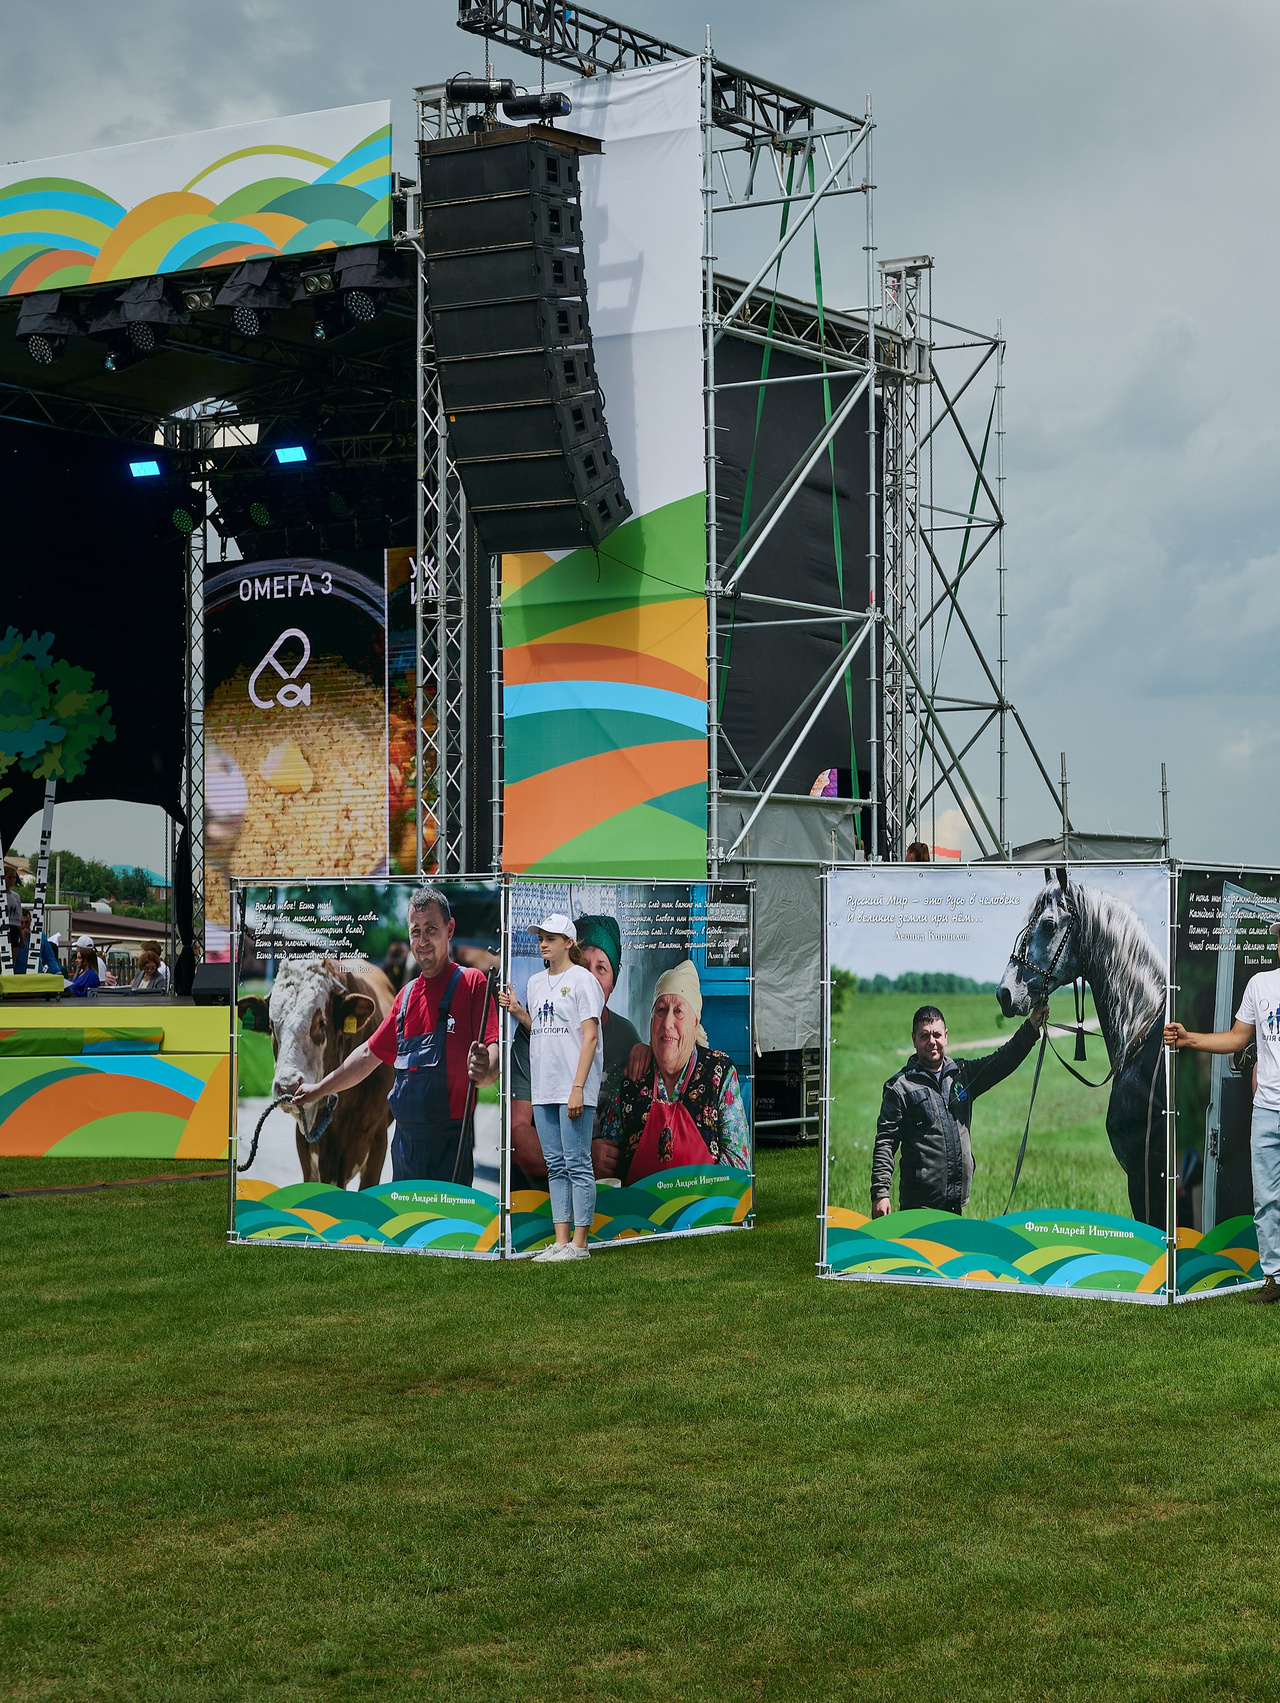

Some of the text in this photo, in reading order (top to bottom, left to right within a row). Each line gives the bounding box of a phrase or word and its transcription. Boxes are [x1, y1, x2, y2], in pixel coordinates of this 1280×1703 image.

[239, 571, 333, 602] ОМЕГА 3
[255, 902, 276, 912] Время
[299, 901, 315, 910] Есть
[318, 900, 332, 910] ты!
[846, 894, 883, 911] Русский
[886, 895, 908, 910] Мир
[924, 897, 942, 906] это
[945, 895, 966, 911] Русь
[969, 892, 975, 905] в
[980, 893, 1020, 906] человеке
[254, 914, 271, 923] Есть
[320, 915, 354, 926] поступки,
[358, 911, 379, 921] слова.
[846, 914, 854, 922] И
[857, 911, 894, 922] великие
[898, 914, 928, 928] земли
[932, 914, 948, 926] при
[1188, 908, 1214, 918] Каждый
[1216, 908, 1228, 919] день
[254, 927, 270, 936] Есть
[894, 930, 970, 942] Леонид Корнилов
[1248, 925, 1268, 936] самый
[255, 939, 271, 948] Есть
[256, 952, 272, 960] Есть
[274, 952, 286, 960] над
[340, 949, 369, 960] рассвет.
[1244, 956, 1272, 964] Павел Воля
[656, 1176, 730, 1190] Фото Андрей Ишутинов
[390, 1192, 476, 1205] Фото Андрей Ишутинов
[1025, 1222, 1134, 1239] Фото Андрей Ишутинов
